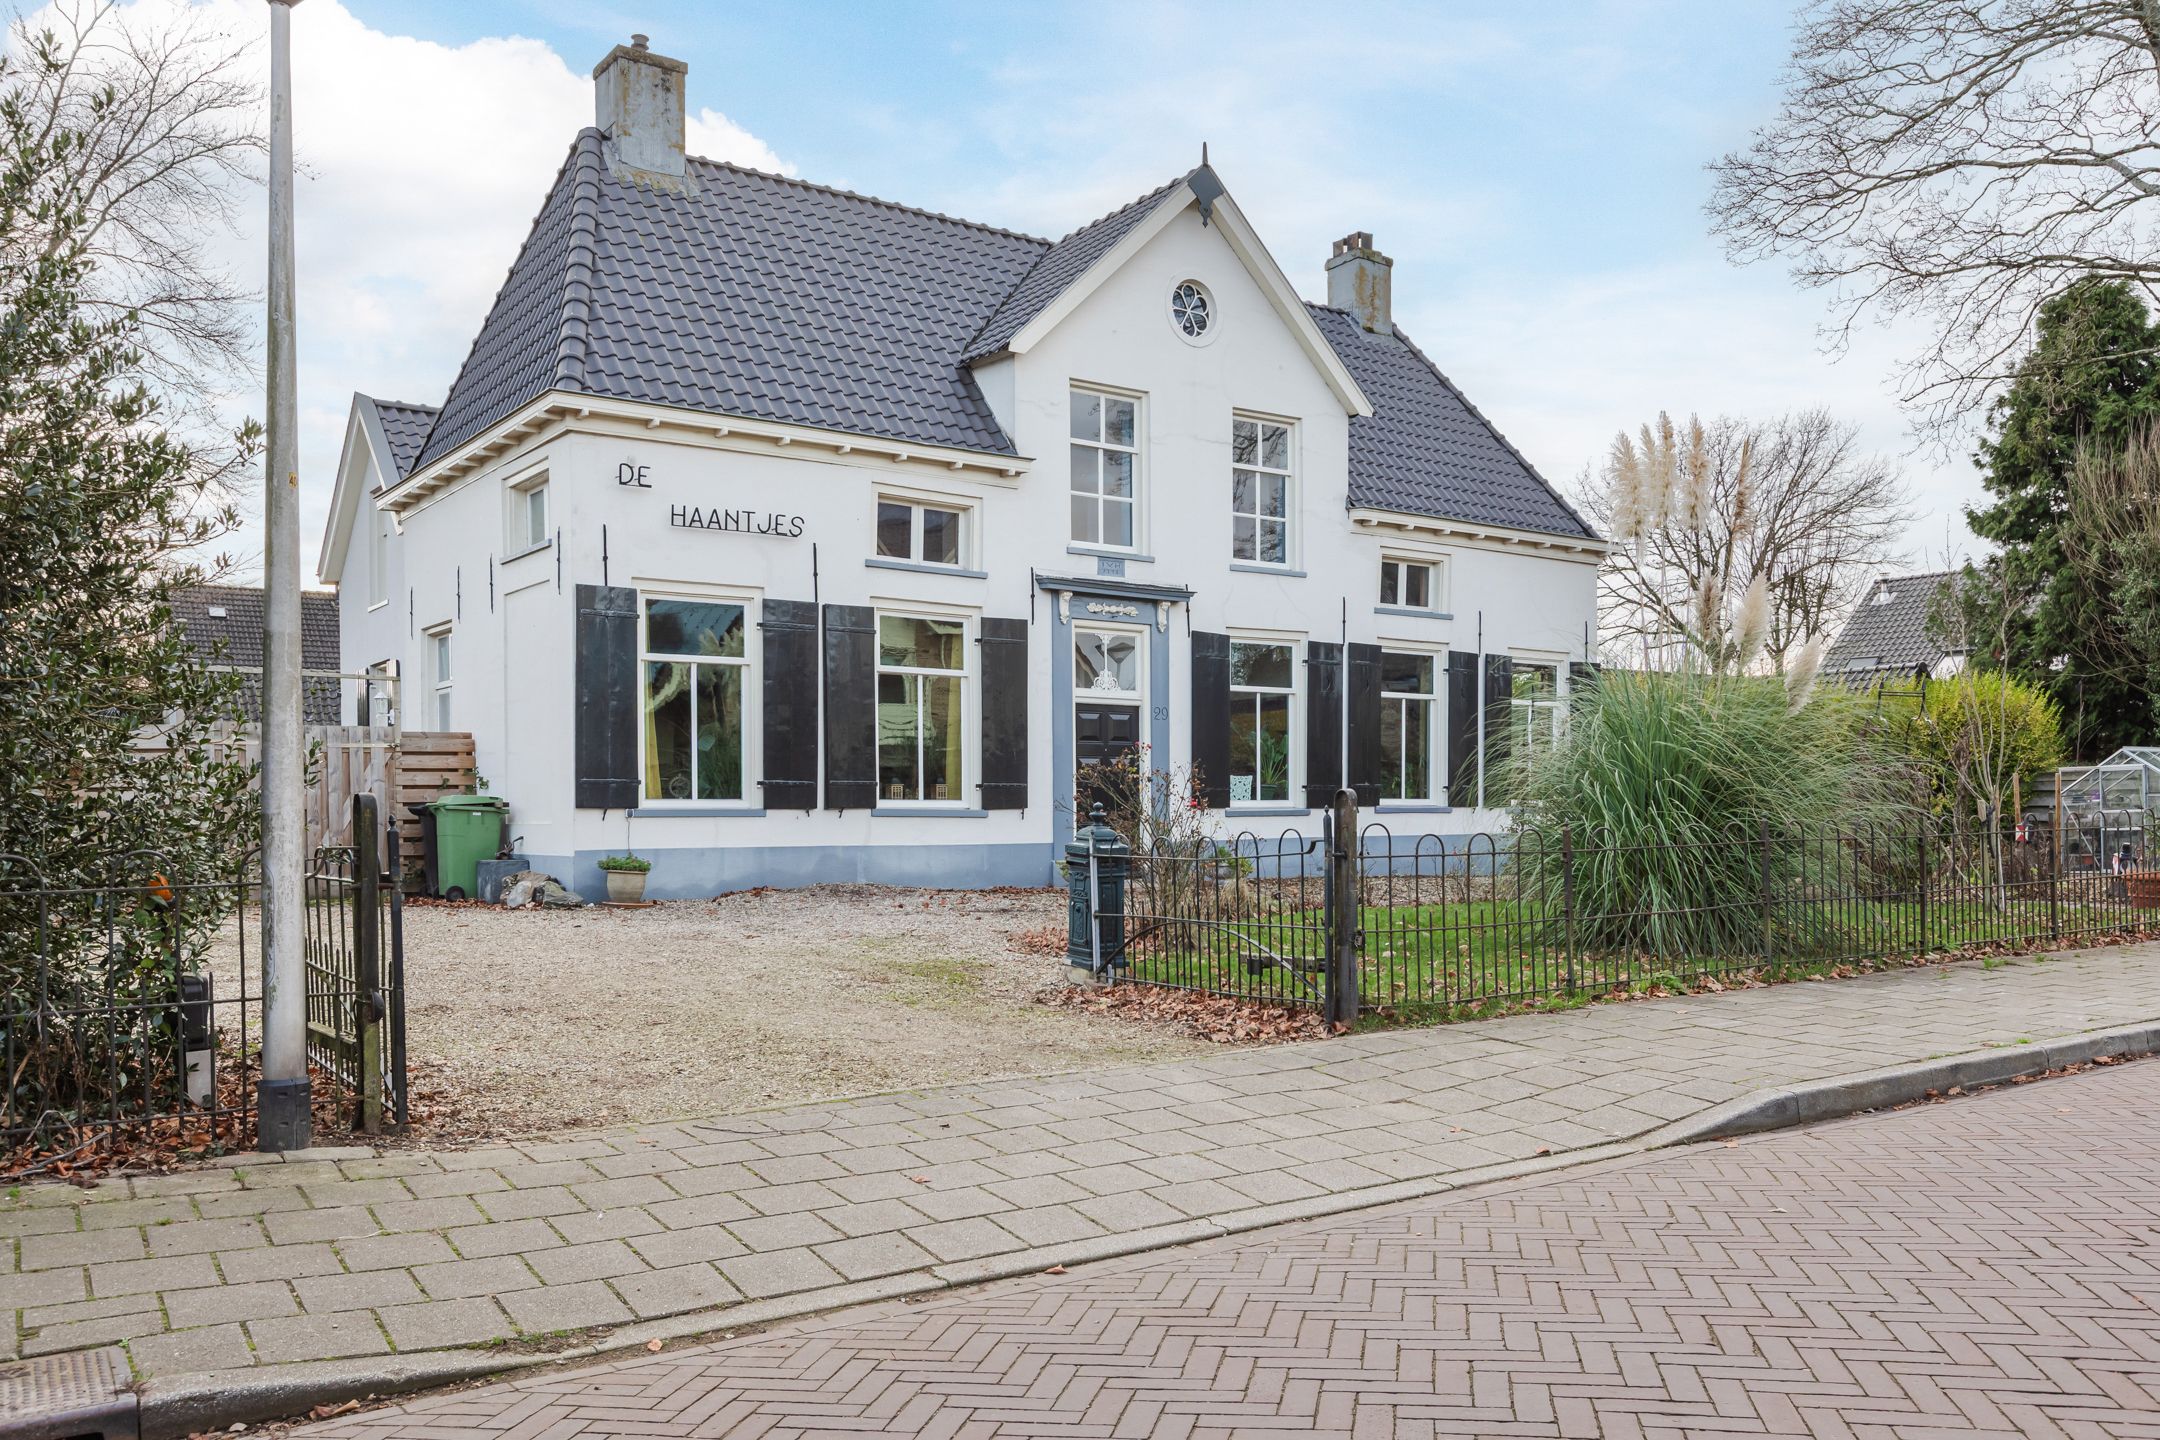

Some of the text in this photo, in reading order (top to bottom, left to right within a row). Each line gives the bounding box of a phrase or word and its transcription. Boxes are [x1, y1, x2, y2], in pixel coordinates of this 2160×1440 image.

[619, 463, 652, 488] DE
[671, 504, 805, 538] HAANTJES
[1153, 706, 1169, 720] 29
